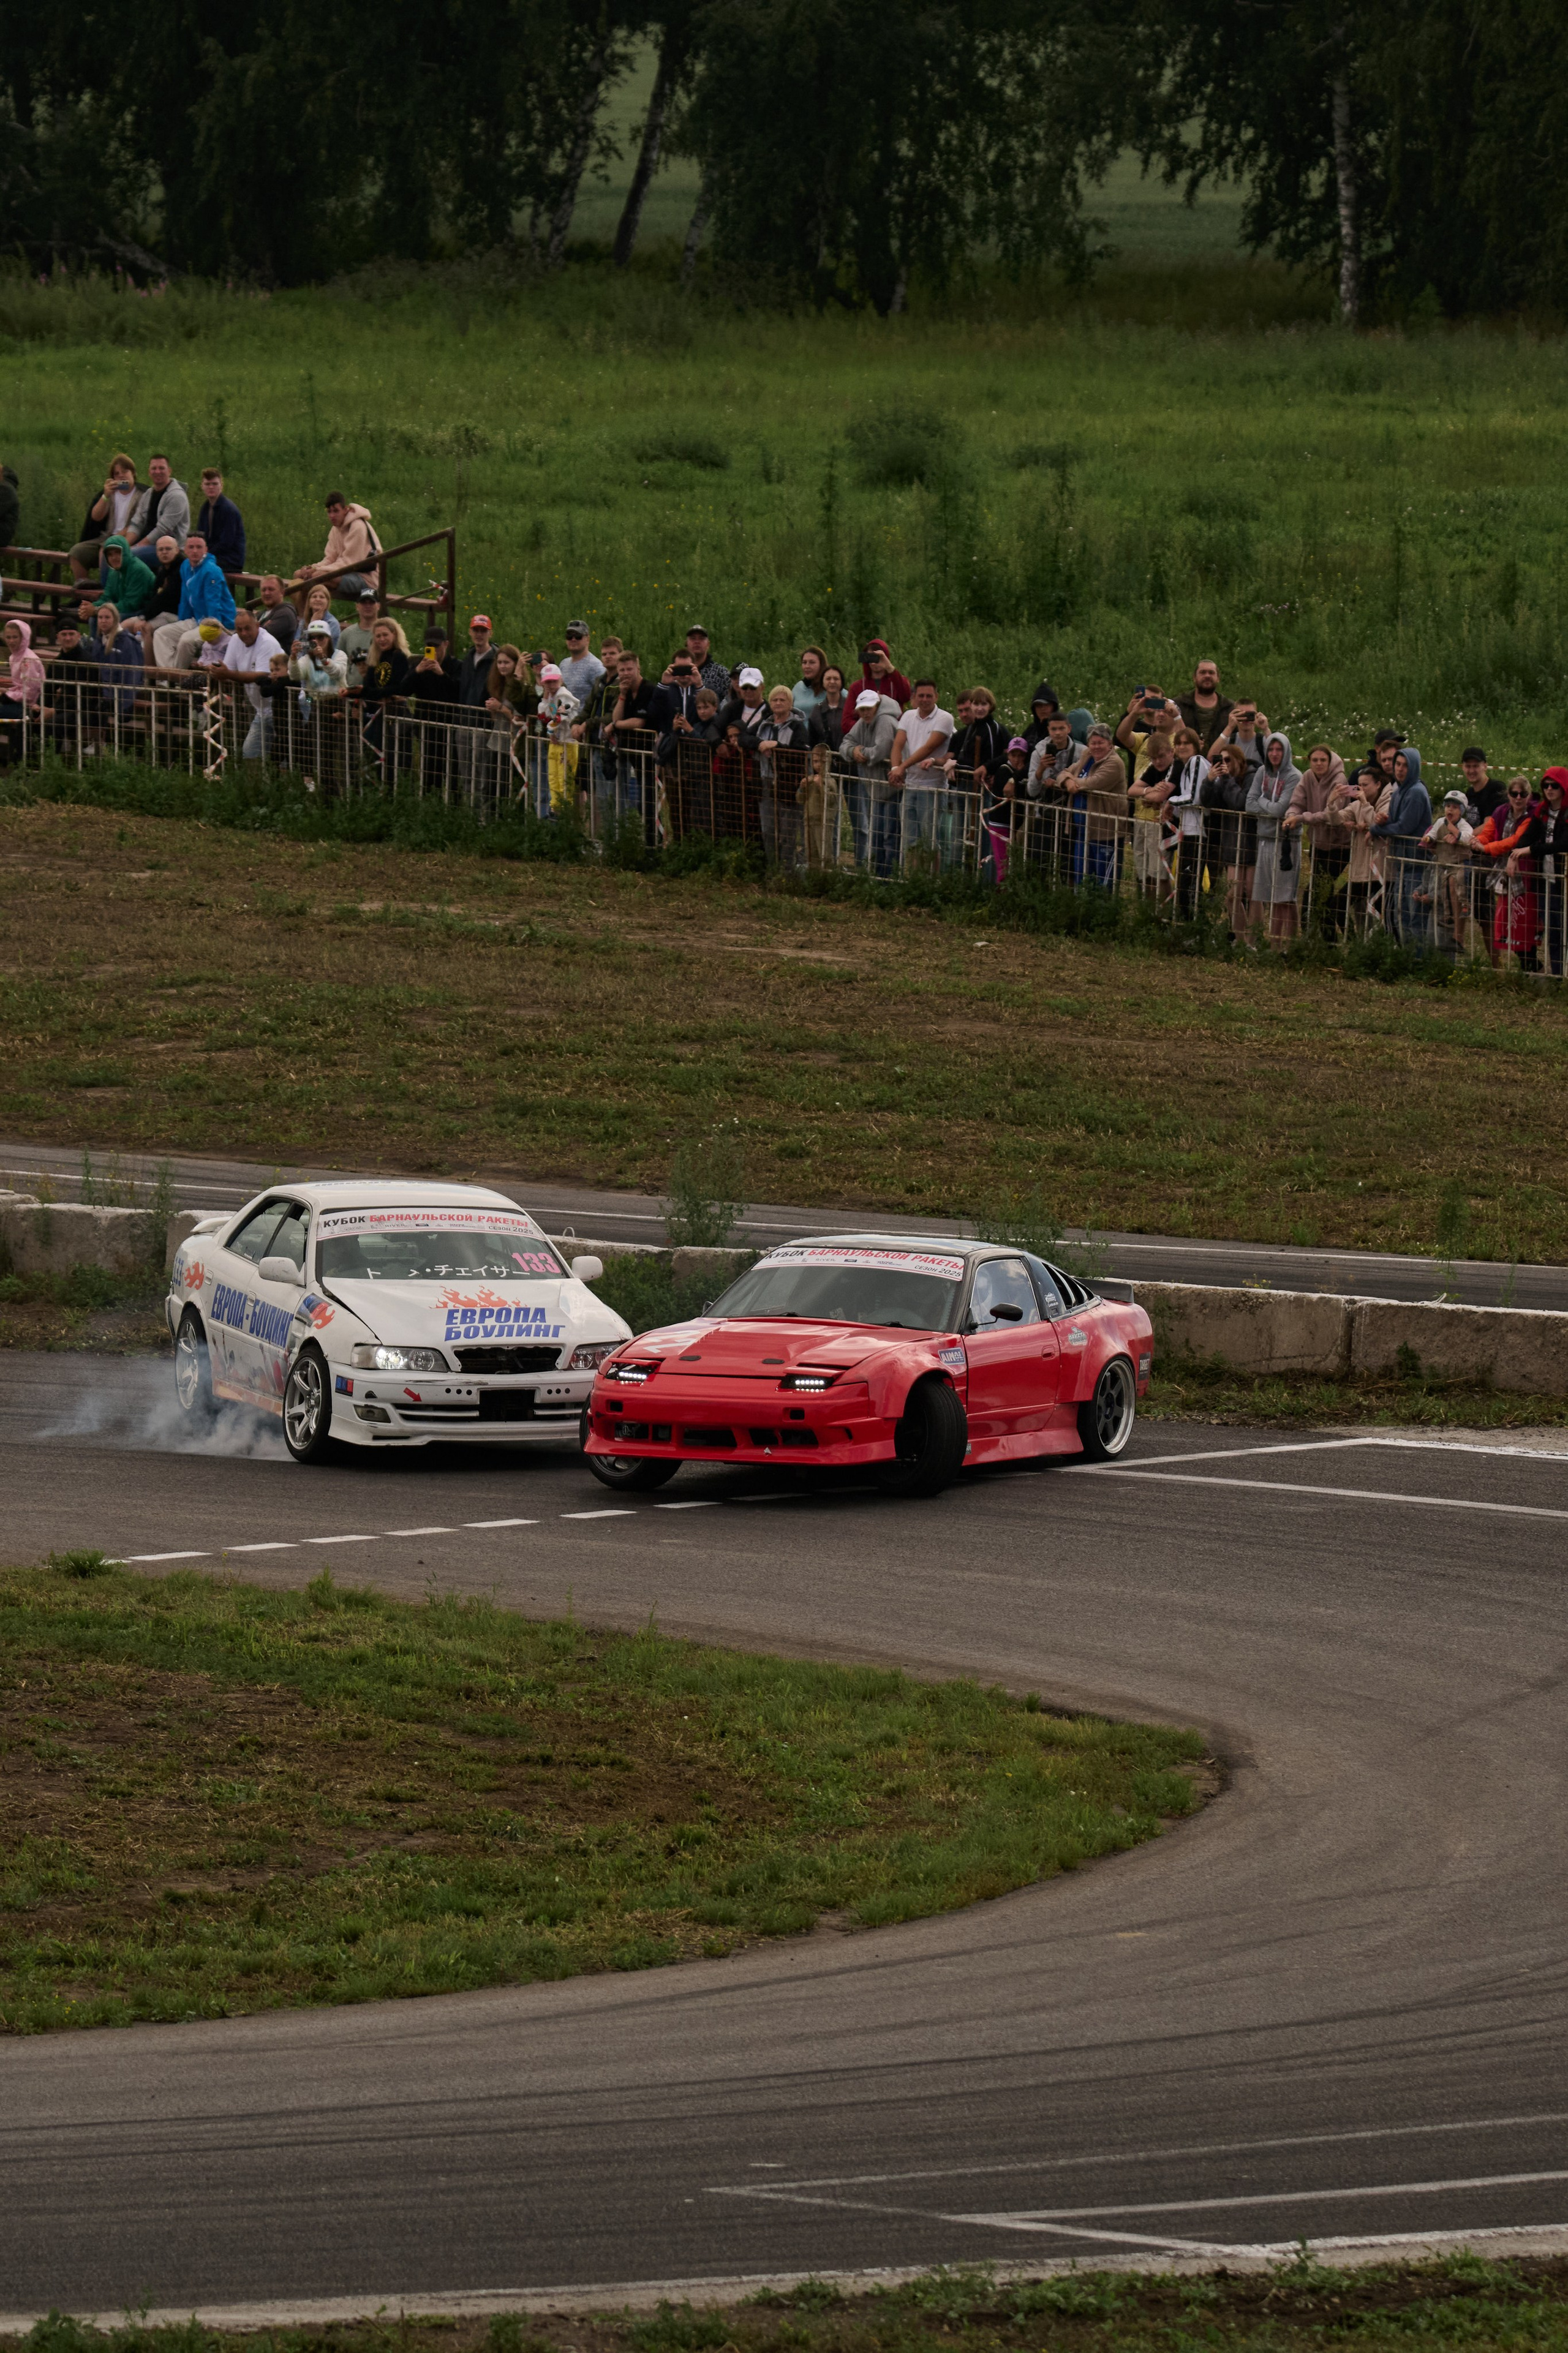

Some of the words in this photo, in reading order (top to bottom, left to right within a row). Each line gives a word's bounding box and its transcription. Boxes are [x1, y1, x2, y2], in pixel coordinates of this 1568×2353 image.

[323, 1216, 366, 1228] КУБОК
[369, 1213, 473, 1222] БАРНАУЛЬСКОЙ
[478, 1215, 529, 1227] РАКЕТЫ
[511, 1252, 561, 1274] 133
[766, 1249, 809, 1259] КУБОК
[808, 1249, 911, 1260] БАРНАУЛЬСКОЙ
[911, 1255, 965, 1270] РАКЕТЫ
[938, 1268, 962, 1277] 2025
[211, 1283, 248, 1330] ЕВРОПА
[445, 1307, 546, 1325] ЕВРОПА
[444, 1324, 566, 1342] БОУЛИНГ
